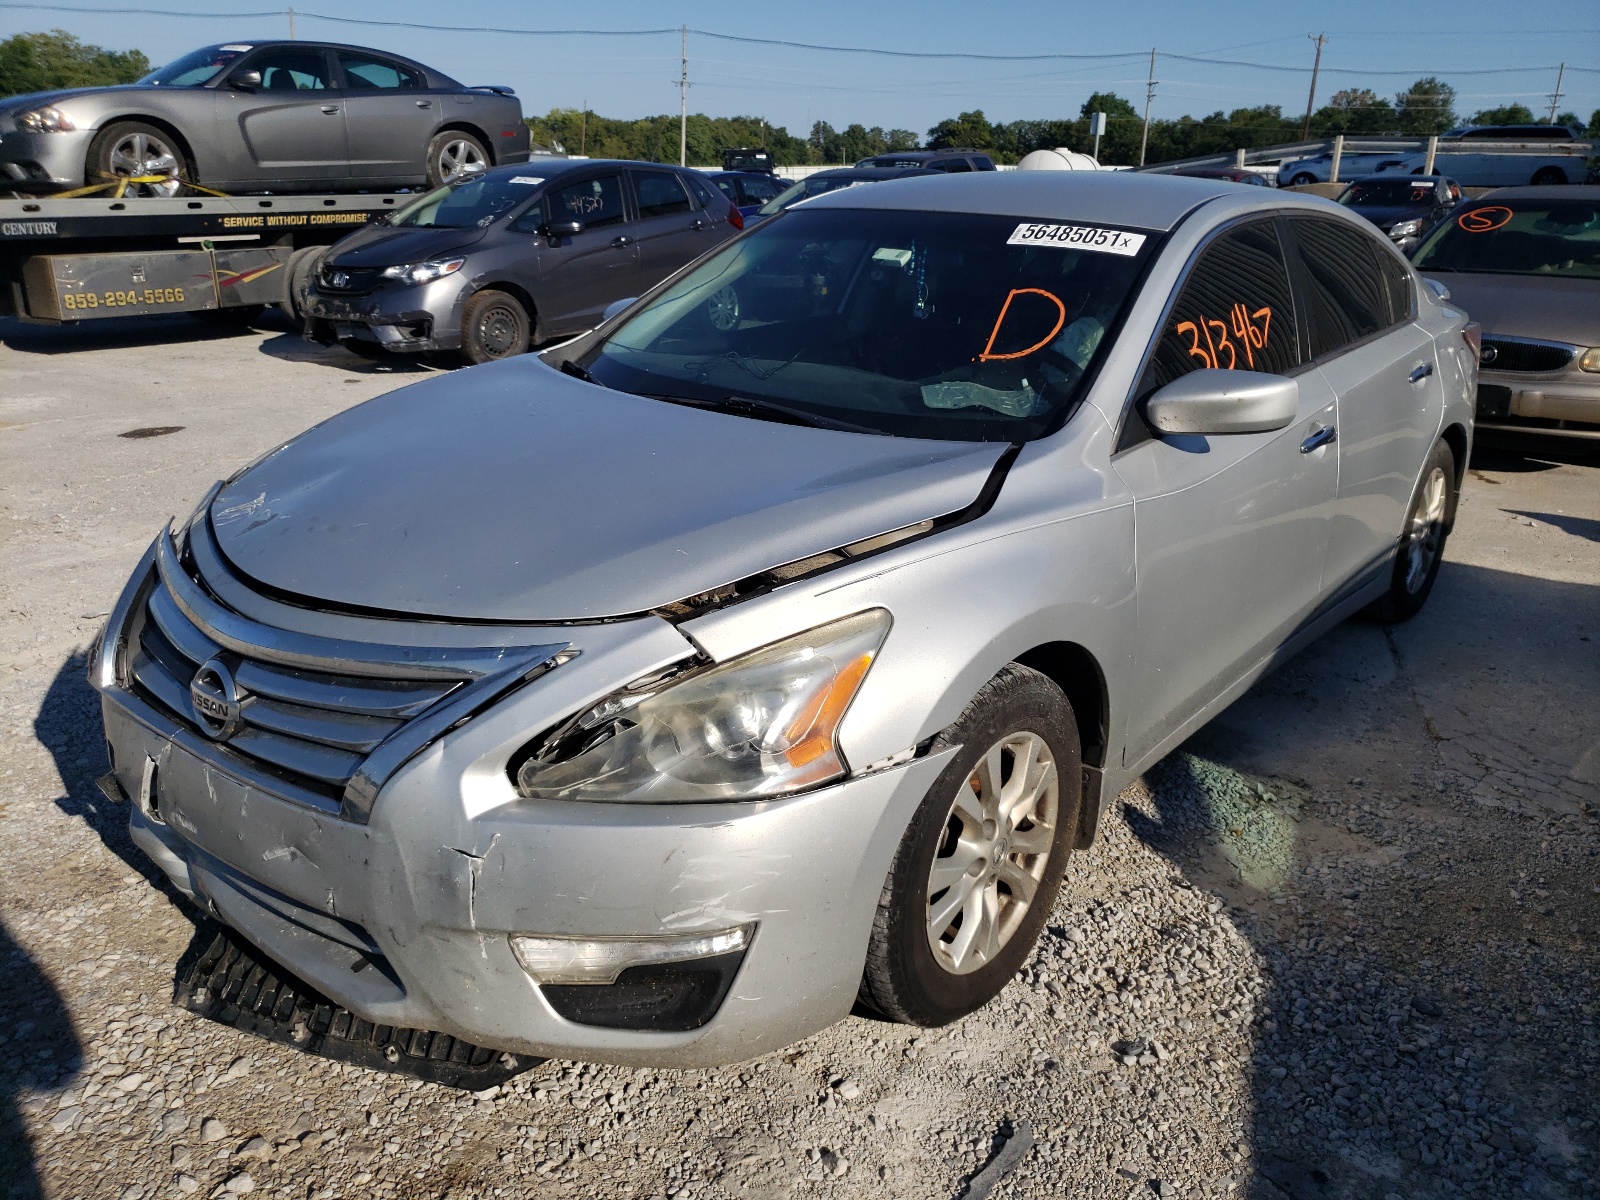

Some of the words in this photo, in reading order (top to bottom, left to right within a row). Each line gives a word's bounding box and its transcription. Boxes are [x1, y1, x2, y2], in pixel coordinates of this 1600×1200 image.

[2, 221, 57, 236] CENTURY
[267, 215, 308, 226] WITHOUT
[64, 287, 185, 310] 859-294-5566
[979, 287, 1066, 363] D
[1177, 303, 1272, 370] 313467
[190, 687, 229, 717] NISSAN
